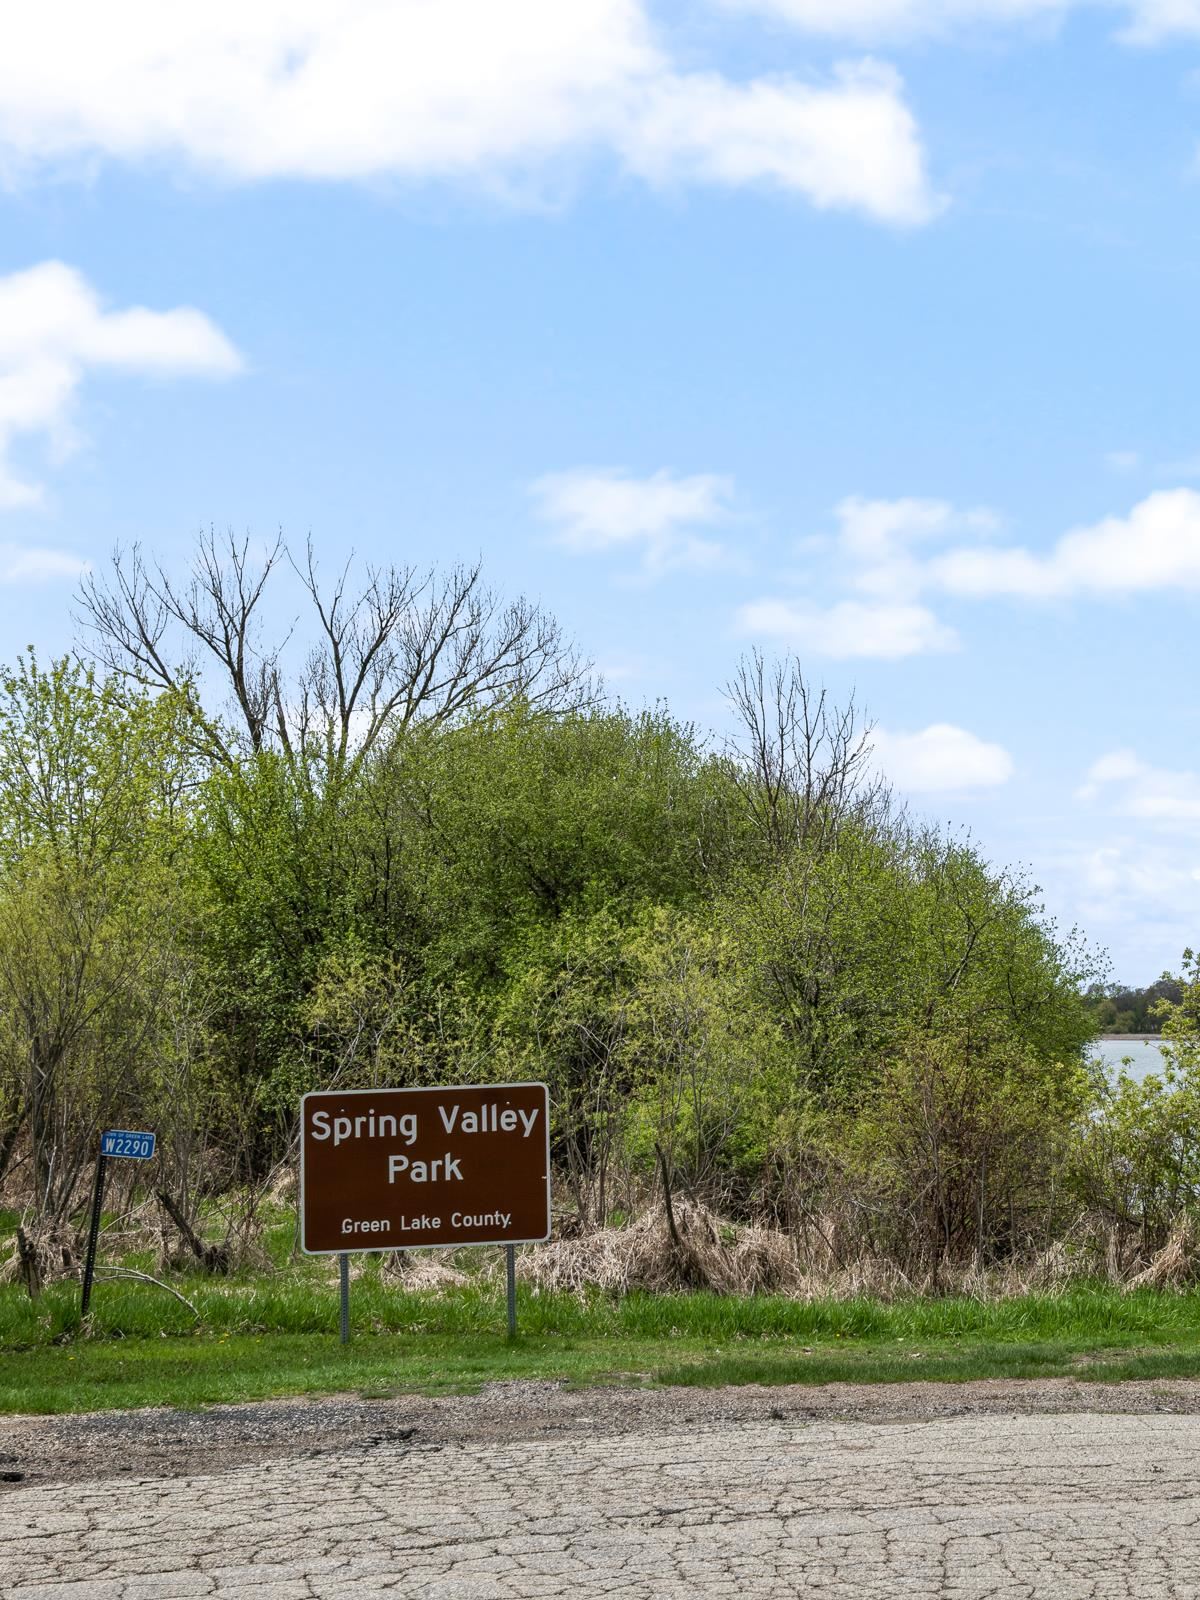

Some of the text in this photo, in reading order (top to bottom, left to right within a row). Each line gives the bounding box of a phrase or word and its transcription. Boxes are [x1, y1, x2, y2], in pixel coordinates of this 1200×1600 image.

[311, 1103, 539, 1146] Spring Valley
[105, 1138, 149, 1155] W2290
[388, 1152, 464, 1184] Park
[342, 1218, 390, 1234] Green
[401, 1214, 442, 1231] Lake
